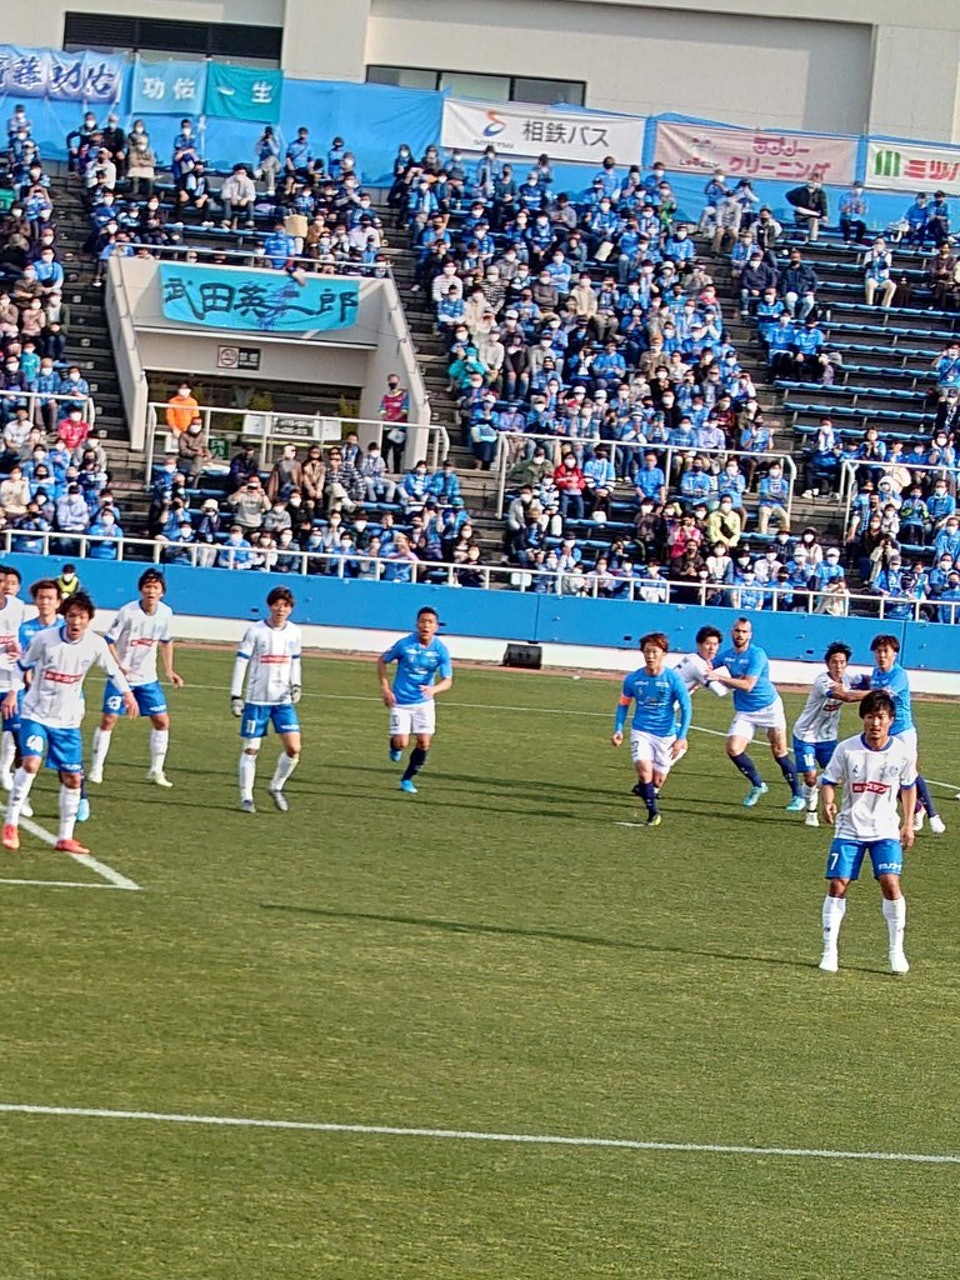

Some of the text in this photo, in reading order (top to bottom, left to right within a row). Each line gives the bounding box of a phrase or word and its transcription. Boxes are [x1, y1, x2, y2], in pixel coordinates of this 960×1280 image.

[523, 120, 610, 148] 相鉄バス
[728, 156, 832, 179] クリーニング
[830, 852, 839, 871] 7
